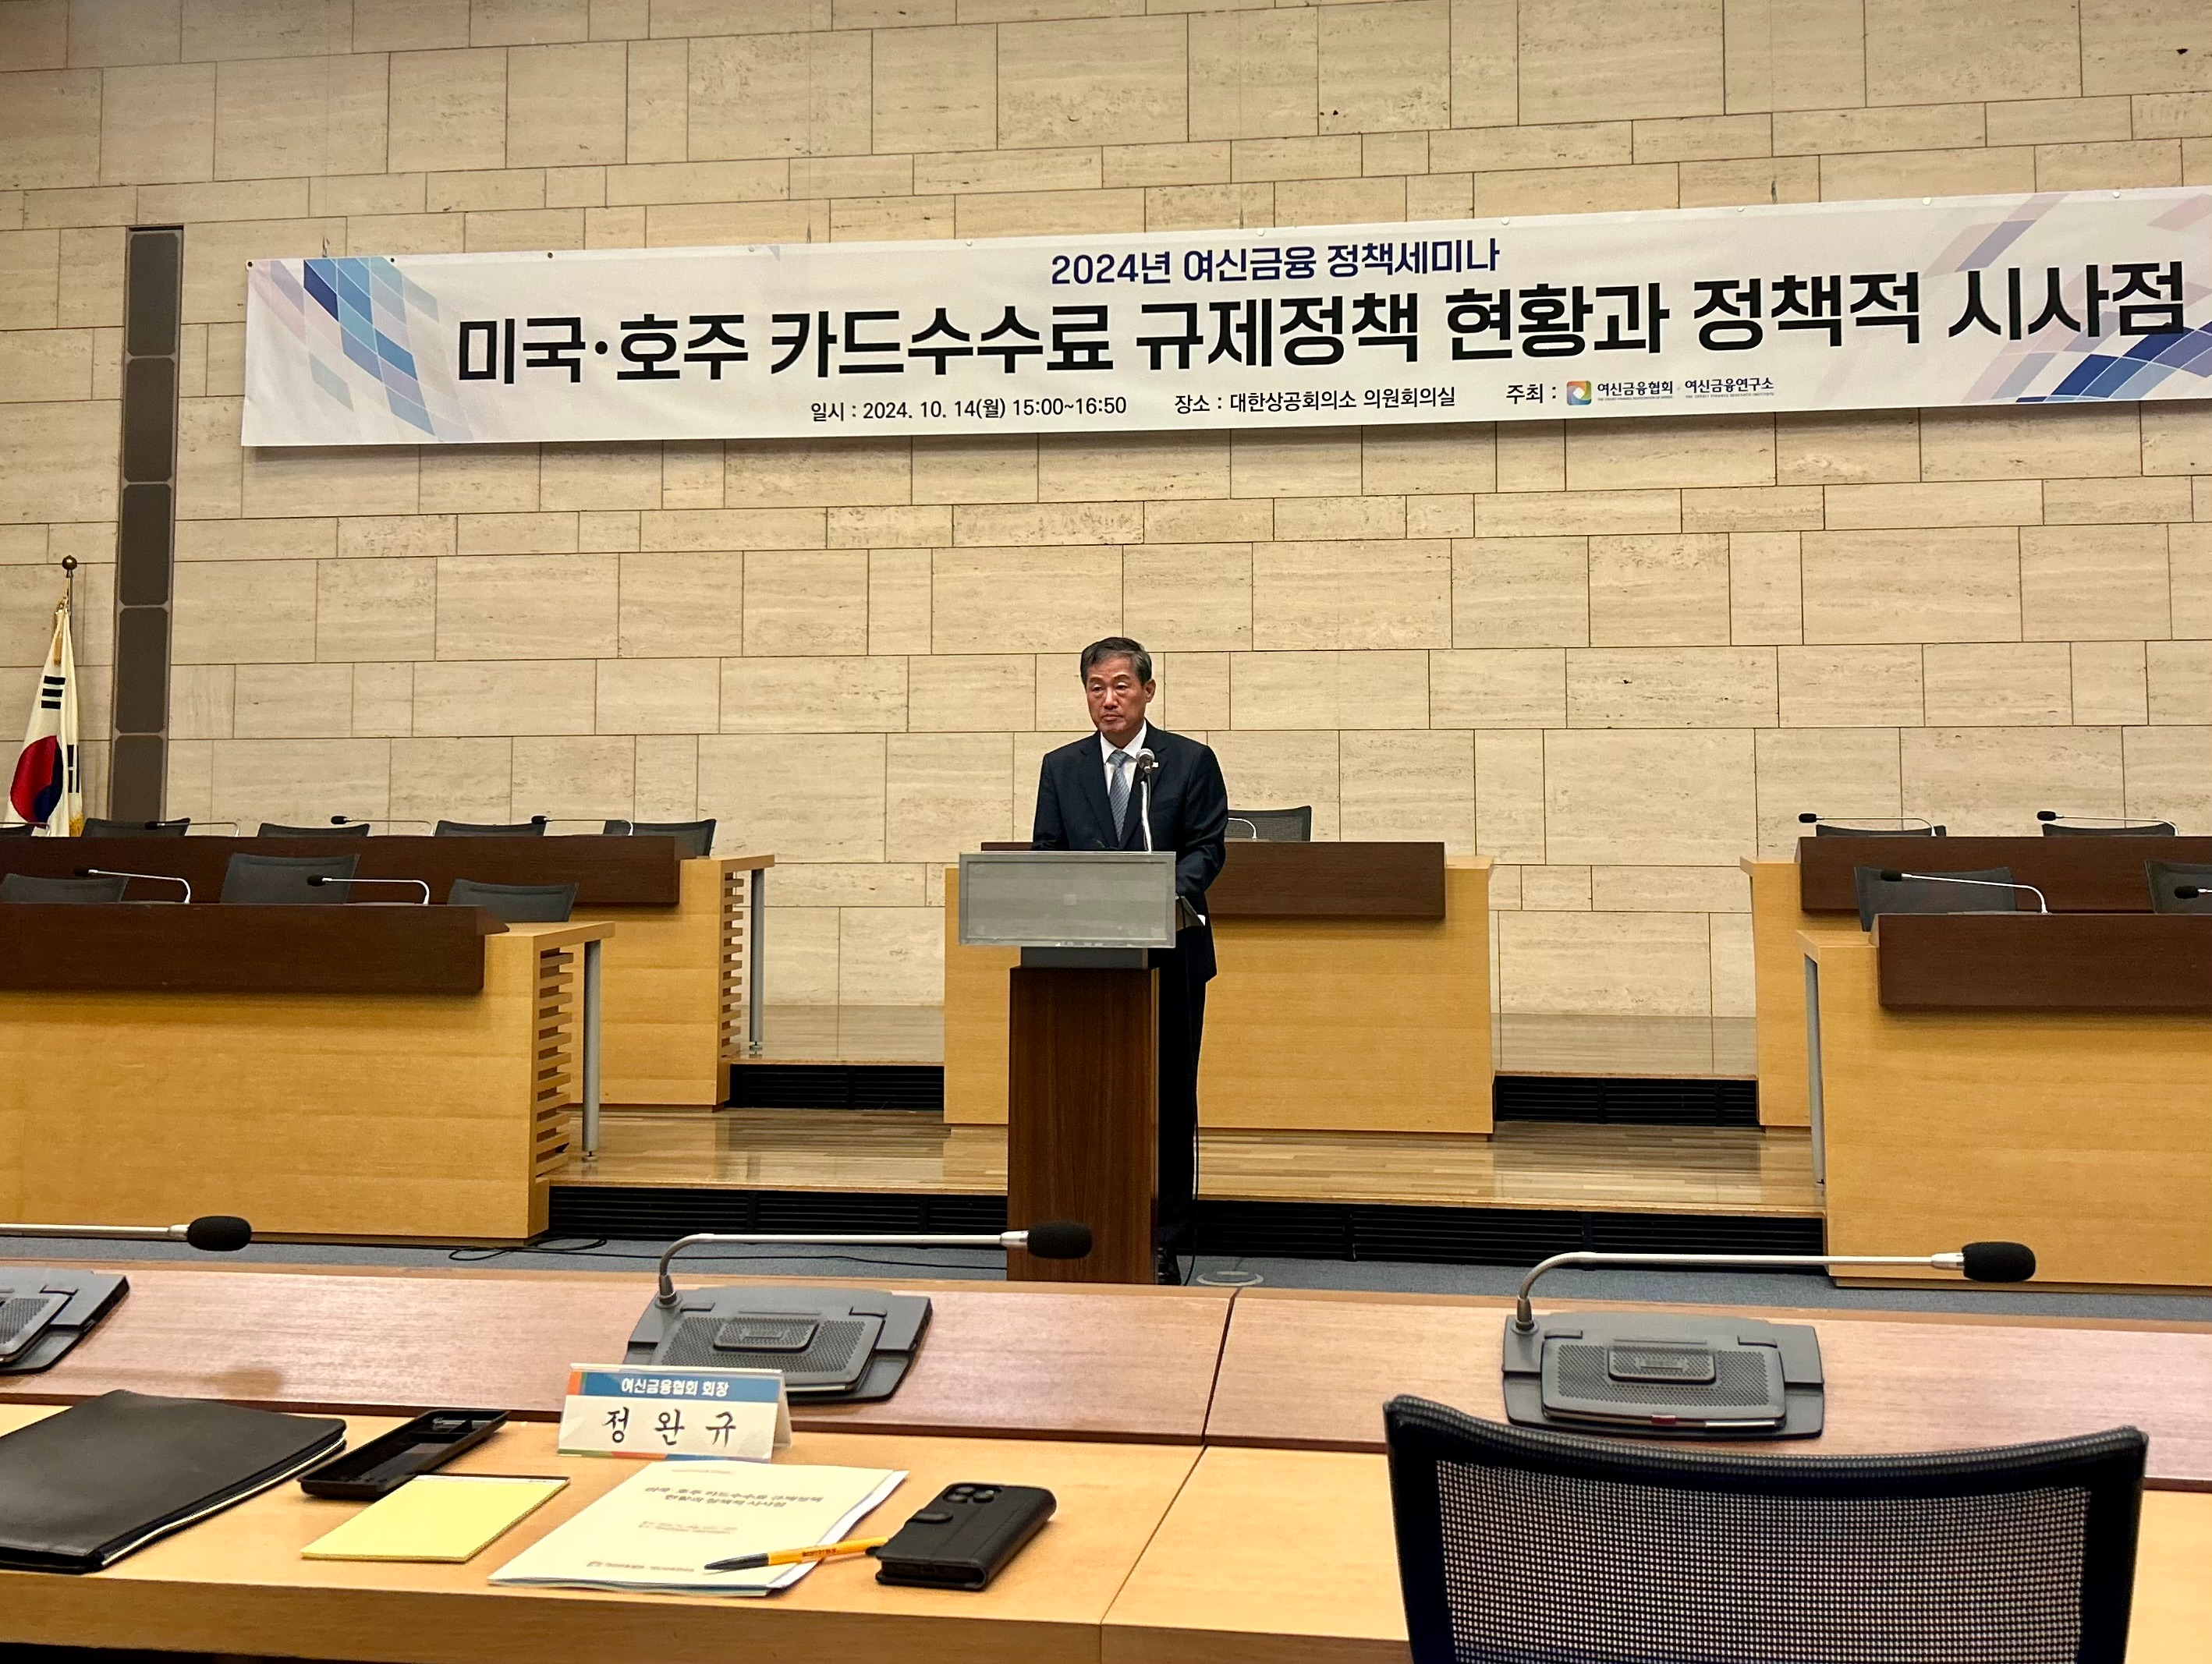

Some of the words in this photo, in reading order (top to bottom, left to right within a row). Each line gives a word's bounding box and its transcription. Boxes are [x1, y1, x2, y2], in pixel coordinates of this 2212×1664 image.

[1051, 251, 1171, 285] 2024년
[1184, 246, 1317, 282] 여신금융
[1327, 238, 1501, 278] 정책세미나
[459, 313, 749, 384] 미국·호주
[771, 305, 1114, 378] 카드수수료
[1136, 292, 1418, 370] 규제정책
[1445, 282, 1671, 361] 현황과
[1693, 271, 1920, 351] 정책적
[1948, 260, 2183, 341] 시사점
[1175, 394, 1211, 415] 장소
[1230, 390, 1357, 412] 대한상공회의소
[1363, 386, 1455, 409] 의원회의실
[1505, 383, 1544, 405] 주최
[1597, 380, 1673, 397] 여신금융협회
[1684, 377, 1774, 394] 여신금융연구소
[811, 402, 844, 422] 일시
[863, 402, 913, 420] 2024.
[920, 400, 947, 418] 10.
[954, 398, 1005, 420] 14(월)
[1012, 396, 1127, 416] 15:00~16:50
[621, 1377, 699, 1396] 여신금융협회
[701, 1380, 729, 1397] 회장
[601, 1406, 630, 1443] 정
[654, 1407, 686, 1446] 완
[705, 1411, 736, 1448] 규
